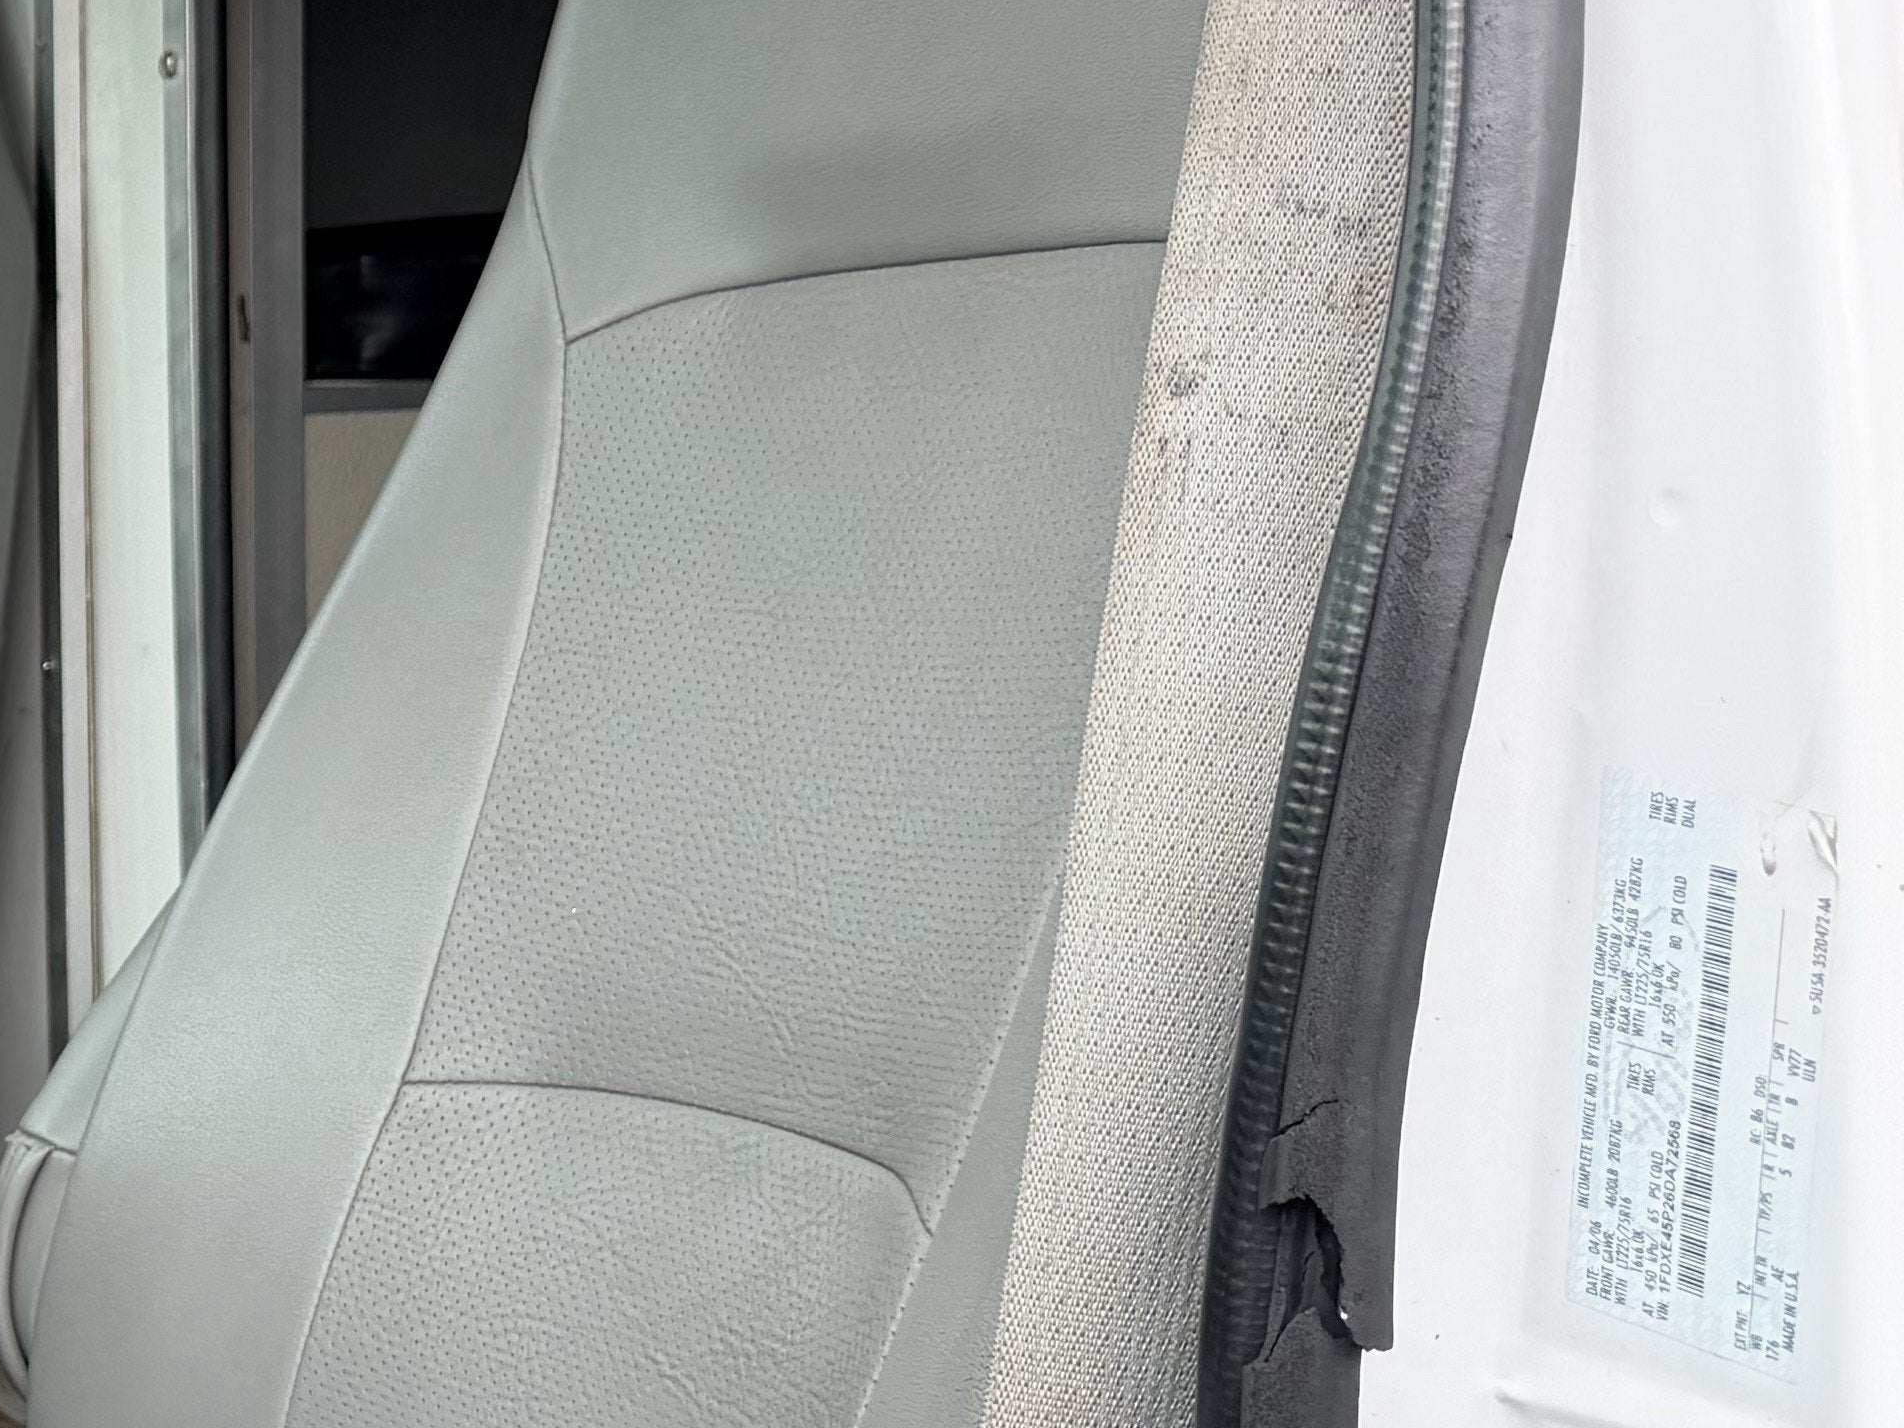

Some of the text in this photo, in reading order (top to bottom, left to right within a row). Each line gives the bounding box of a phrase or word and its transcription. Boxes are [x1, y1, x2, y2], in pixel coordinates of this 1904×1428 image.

[1649, 791, 1664, 820] TIRES
[1664, 796, 1678, 824] RIMS
[1681, 800, 1696, 828] DUAL
[1628, 857, 1643, 901] 4287KG
[1672, 876, 1687, 904] COLD
[1612, 878, 1627, 922] 6373KG
[1625, 908, 1639, 948] 9450LB
[1670, 908, 1684, 926] PSI
[1594, 923, 1608, 976] COMPANY
[1632, 930, 1652, 1037] WITH LT225/75R16
[1590, 980, 1604, 1019] MOTOR
[1618, 1006, 1630, 1034] REAR
[1662, 1004, 1676, 1027] 550
[1588, 1021, 1602, 1050] FORD
[1772, 1042, 1785, 1061] SPR
[1627, 1062, 1641, 1090] TIRES
[1642, 1069, 1656, 1096] RIMS
[1581, 1099, 1596, 1140] VEHICLE
[1765, 1120, 1778, 1145] AXLE
[1577, 1144, 1593, 1208] INCOMPLETE
[1649, 1151, 1664, 1179] COLD
[1648, 1182, 1661, 1200] PSI
[1600, 1266, 1612, 1301] FRONT
[1608, 1119, 1622, 1162] 2087KG
[1660, 1120, 1681, 1293] 1FDXE45P26DA72568
[1589, 1220, 1602, 1254] 04/06
[1615, 1196, 1632, 1305] WITH LT225/75R16
[1645, 1270, 1657, 1291] 450
[1734, 1332, 1746, 1351] EXT
[1782, 1318, 1796, 1353] MADE
[1766, 1340, 1779, 1361] 176
